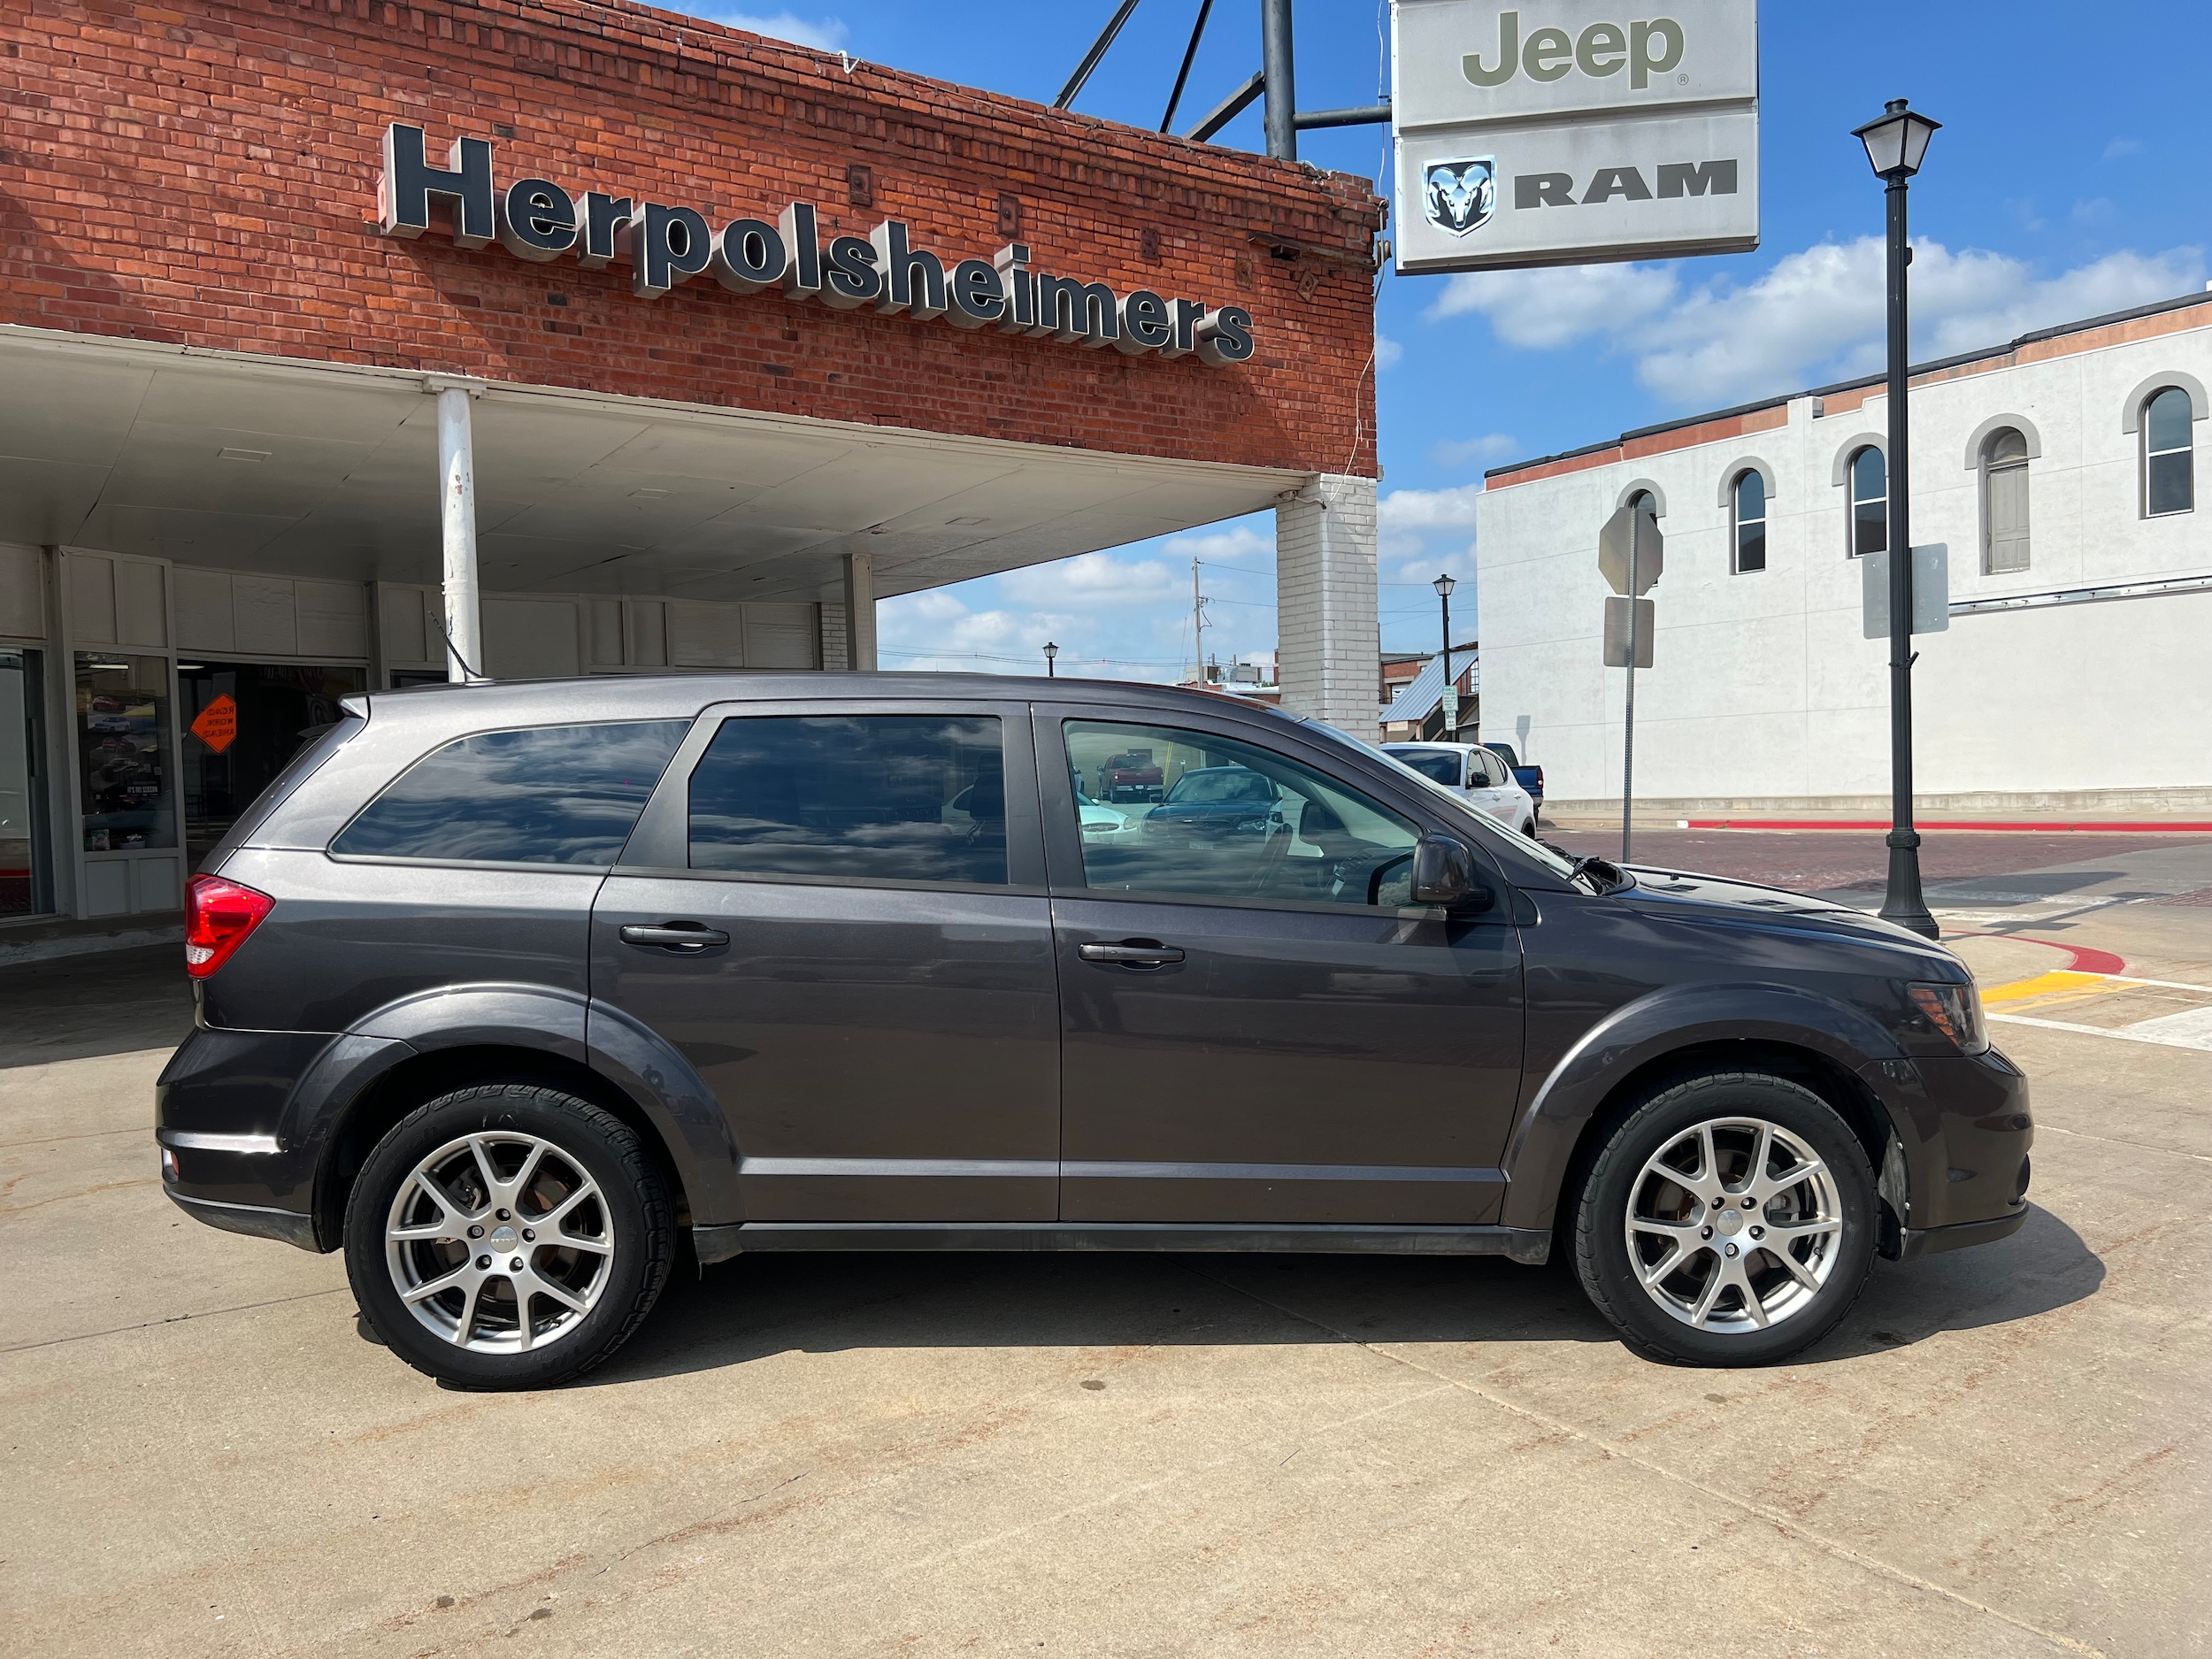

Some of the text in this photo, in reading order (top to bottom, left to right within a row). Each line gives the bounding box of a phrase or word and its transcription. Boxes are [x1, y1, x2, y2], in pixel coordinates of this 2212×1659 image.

[1463, 11, 1686, 90] Jeep
[1514, 158, 1738, 210] RAM
[388, 121, 1255, 365] Herpolsheimers
